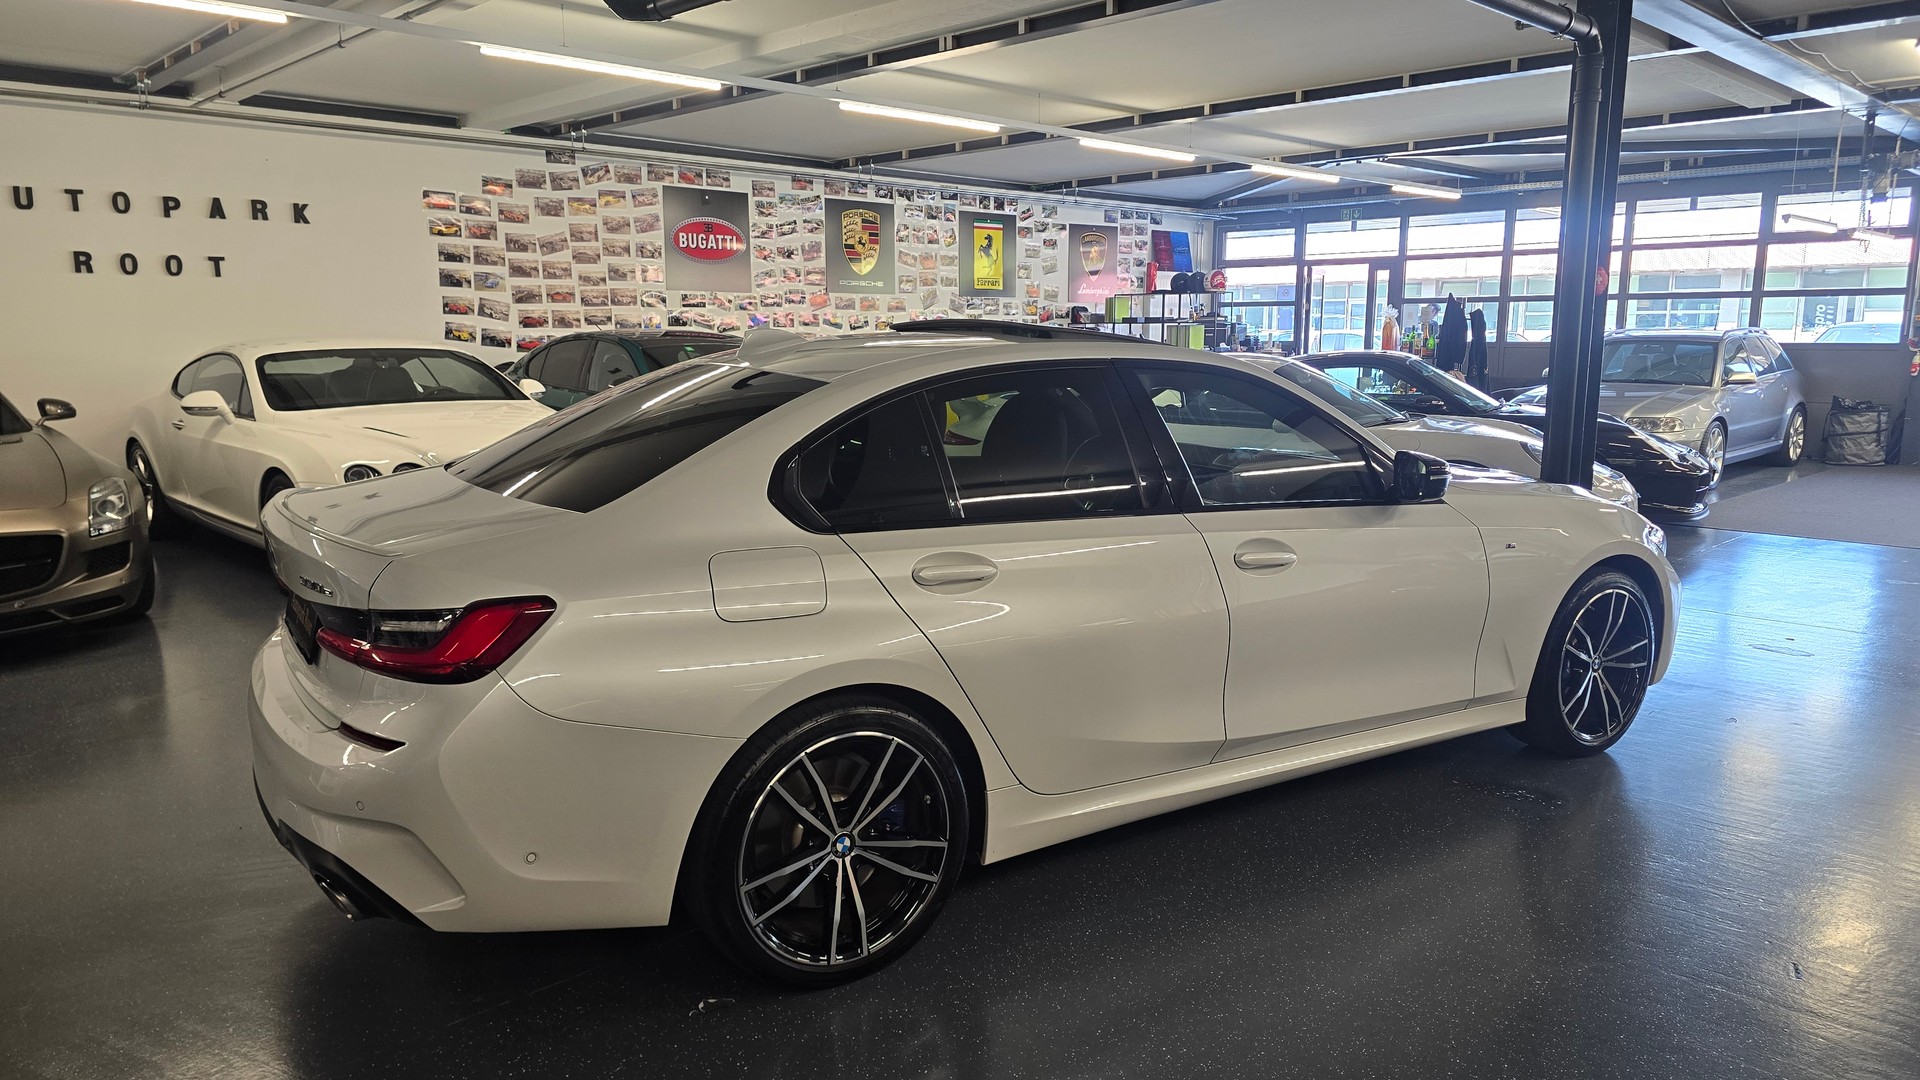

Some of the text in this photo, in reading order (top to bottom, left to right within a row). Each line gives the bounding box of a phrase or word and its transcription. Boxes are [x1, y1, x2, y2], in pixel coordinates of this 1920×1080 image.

[679, 232, 737, 251] BUGATTI
[73, 250, 226, 278] ROOT
[977, 277, 1001, 287] Ferrari
[1077, 283, 1111, 297] Lamborghini
